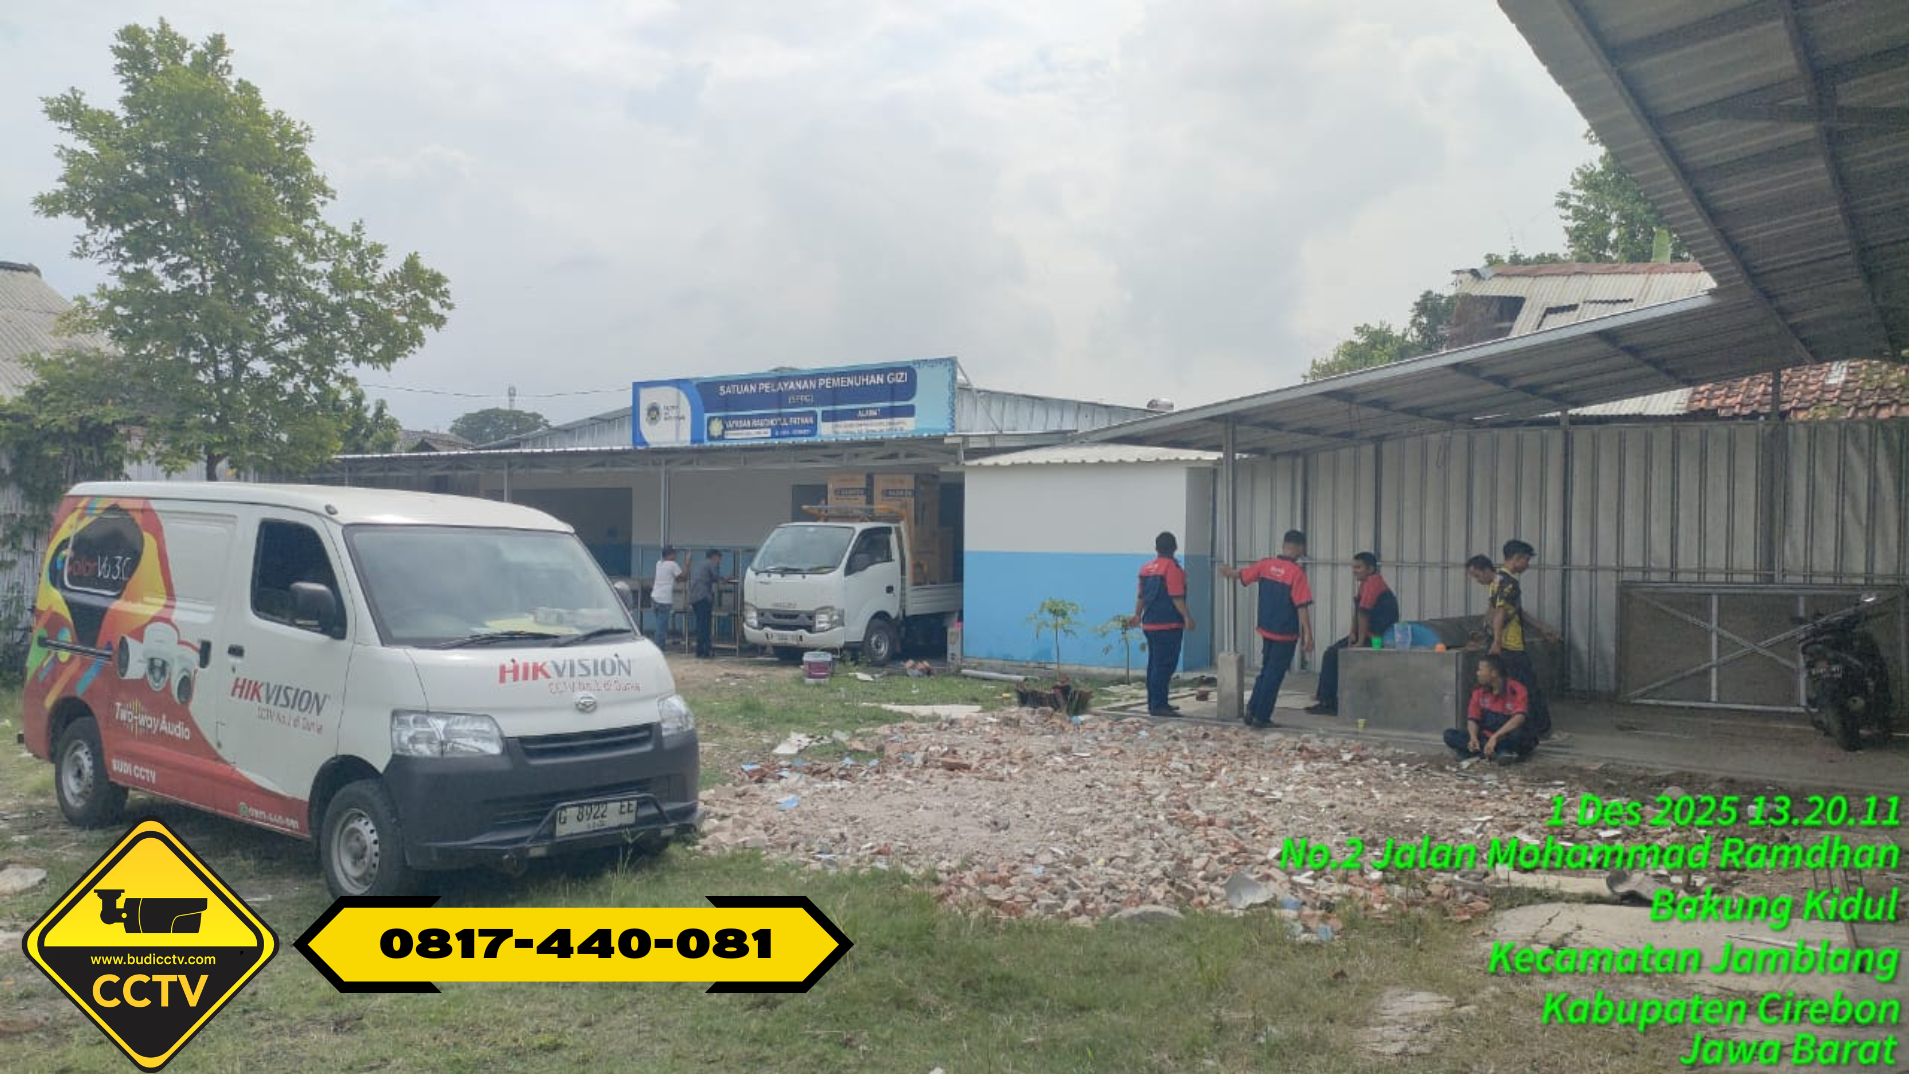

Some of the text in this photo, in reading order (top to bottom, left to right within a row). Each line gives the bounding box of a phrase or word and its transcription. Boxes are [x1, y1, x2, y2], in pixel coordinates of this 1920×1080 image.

[719, 371, 908, 396] SATUAN PELAYANAN PEMENUHAN GIZI
[498, 657, 632, 685] HIKVISION
[231, 677, 328, 717] HIKVISION
[133, 765, 156, 784] CCTV
[558, 804, 568, 825] G
[576, 801, 608, 822] 8922
[619, 799, 635, 815] EE
